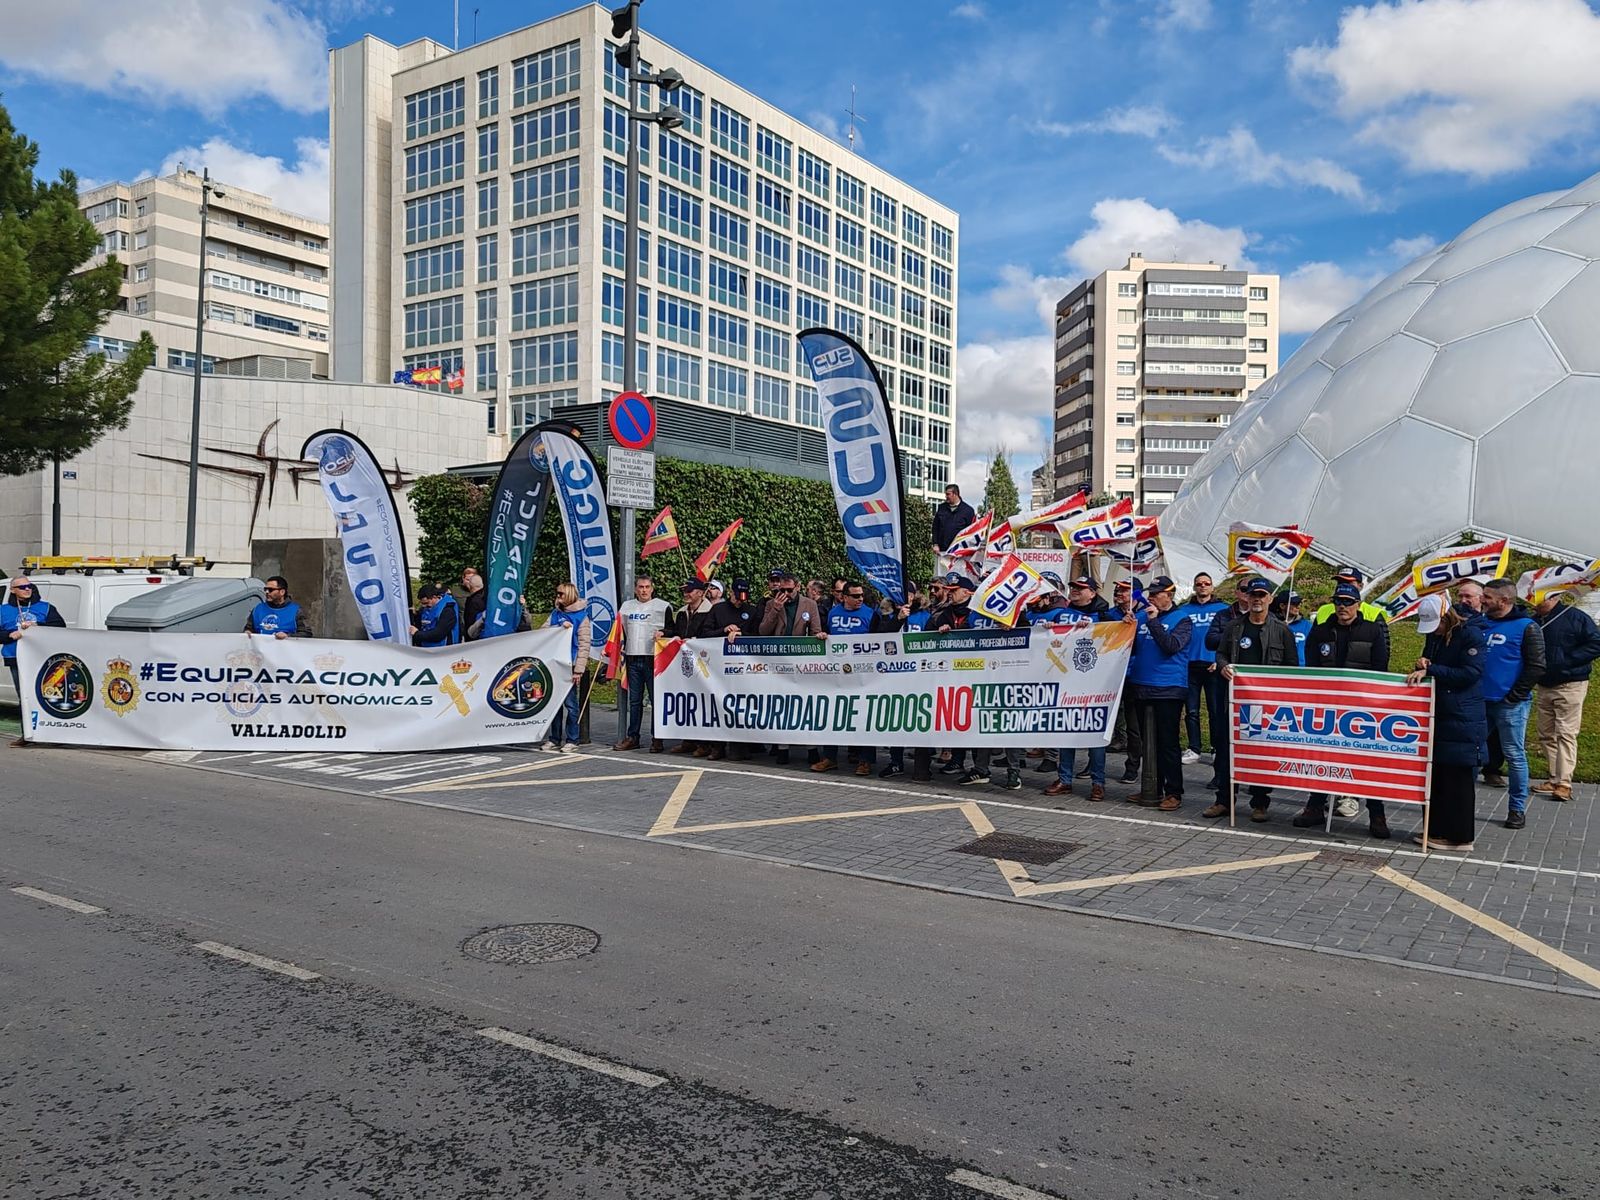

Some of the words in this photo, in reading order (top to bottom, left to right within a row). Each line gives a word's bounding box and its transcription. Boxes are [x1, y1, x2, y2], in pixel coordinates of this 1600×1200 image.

[493, 482, 541, 627] JUSAPOL
[1022, 552, 1064, 563] DERECHOS
[1238, 538, 1298, 560] SUP
[985, 571, 1029, 614] SUP
[831, 616, 862, 628] SUP
[727, 643, 749, 653] SOMOS
[750, 644, 761, 653] LOS
[762, 644, 778, 654] PEOR
[831, 643, 849, 653] SPP
[853, 643, 881, 654] SUP
[724, 667, 744, 675] AEGC
[889, 660, 917, 670] AUGC
[145, 691, 183, 703] CON
[192, 692, 282, 704] POLICIAS
[288, 692, 433, 706] AUTONÓMICAS
[972, 685, 983, 707] A
[984, 685, 1002, 707] LA
[1003, 682, 1056, 707] CESIÓN
[662, 692, 698, 727] POR
[700, 692, 720, 728] LA
[723, 693, 830, 731] SEGURIDAD
[832, 694, 861, 732] DE
[865, 693, 933, 733] TODOS
[935, 685, 973, 732] NO
[980, 710, 998, 733] DE
[1000, 708, 1105, 733] COMPETENCIAS
[1267, 705, 1420, 744] AUGC
[231, 723, 347, 739] VALLADOLID
[1266, 733, 1304, 743] Asociación
[1305, 736, 1340, 747] Unificada
[1341, 740, 1351, 748] de
[1352, 740, 1389, 752] Guardias
[1277, 759, 1354, 781] ZAMORA
